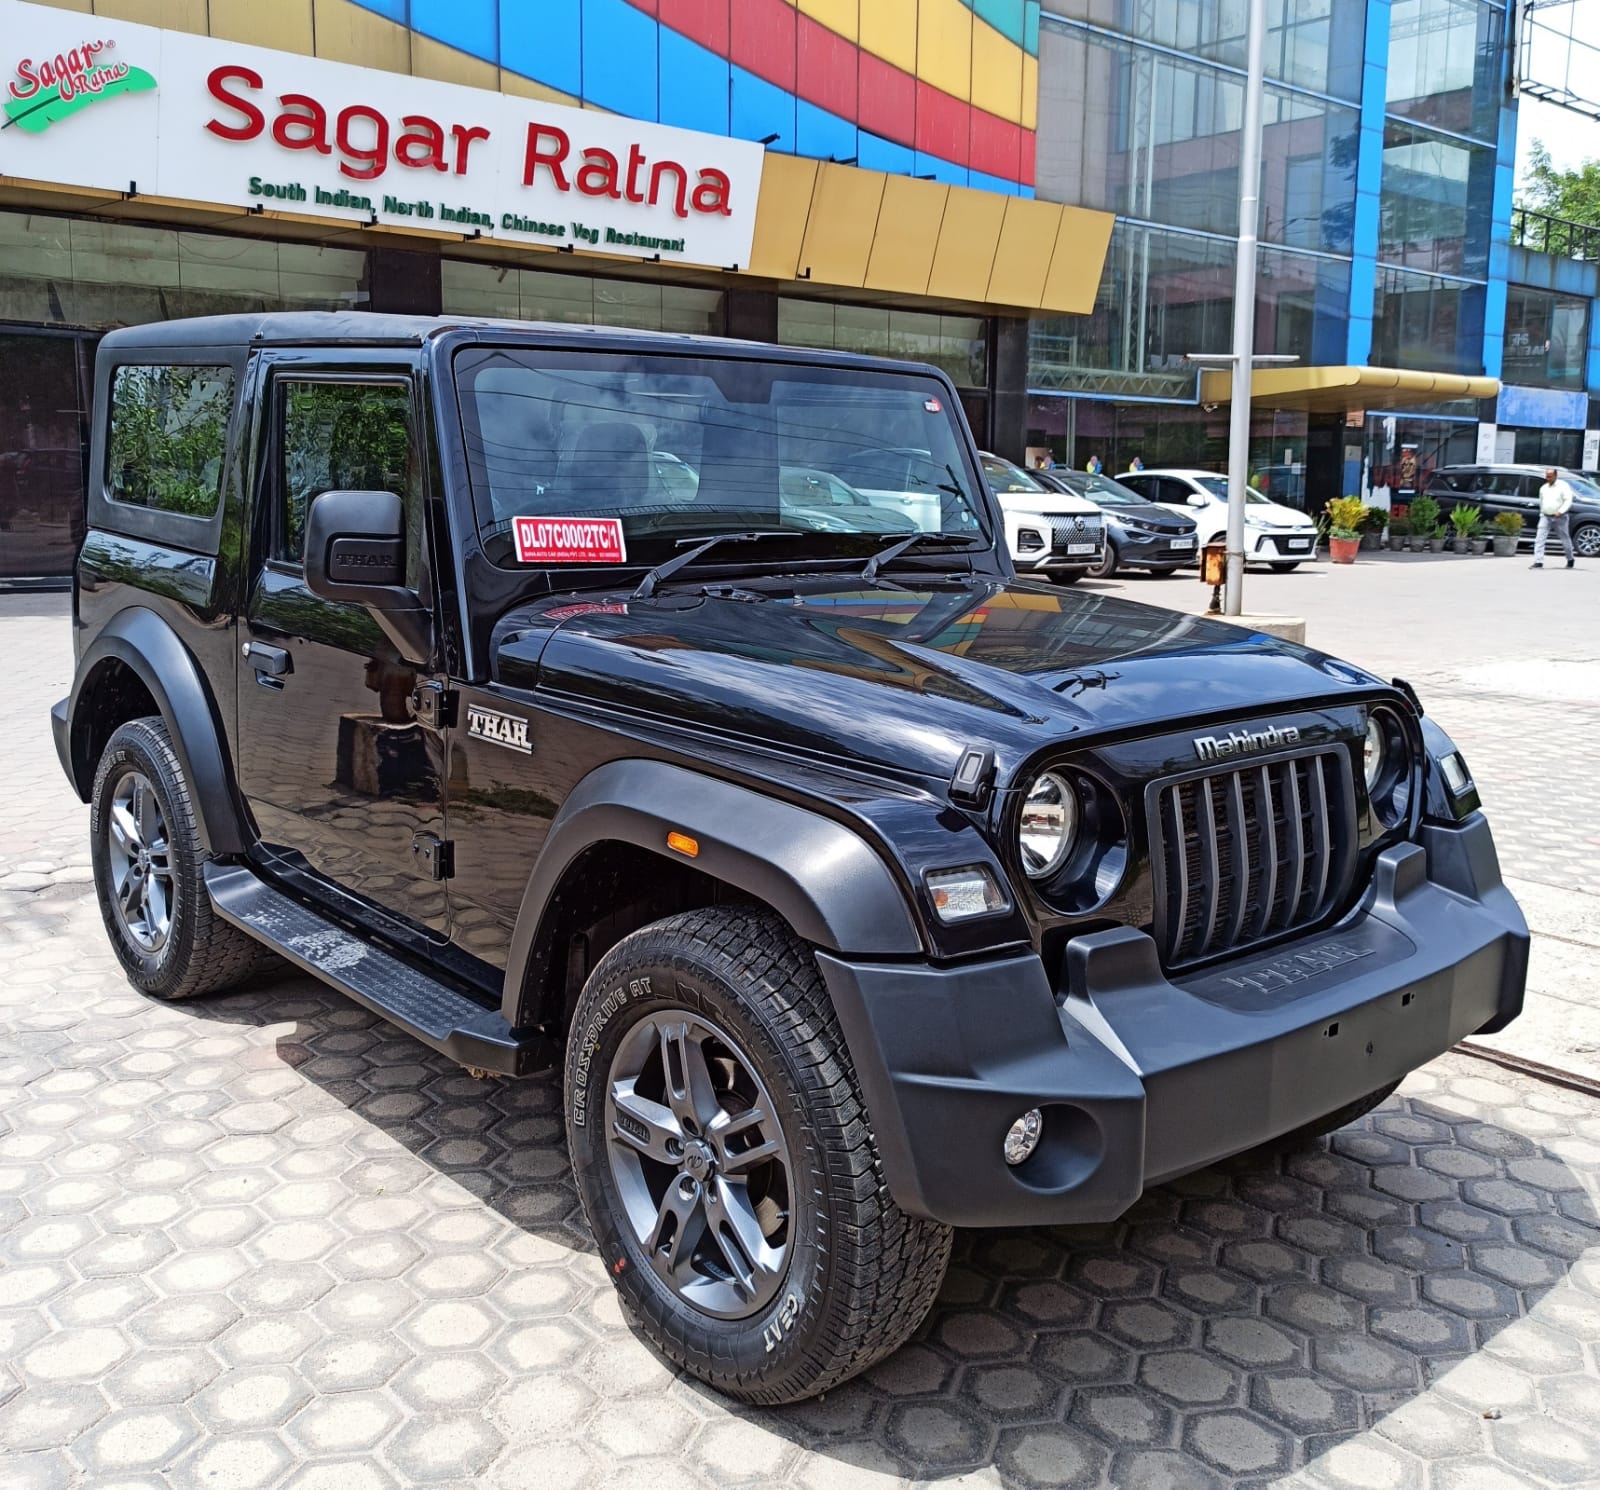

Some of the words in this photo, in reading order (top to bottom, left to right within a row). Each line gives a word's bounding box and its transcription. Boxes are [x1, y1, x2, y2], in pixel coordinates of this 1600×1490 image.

[9, 39, 103, 101] Sagar
[73, 62, 128, 93] Ratna
[204, 65, 491, 181] Sagar
[521, 121, 732, 219] Ratna
[249, 176, 307, 201] South
[315, 185, 376, 215] Indian,
[383, 194, 434, 219] North
[440, 203, 495, 229] Indian,
[502, 213, 566, 237] Chinese
[571, 221, 600, 244] Veg
[605, 227, 685, 252] Restaurant
[520, 523, 619, 549] DL07C0002TC/1
[1193, 725, 1301, 760] Mahindra
[573, 987, 628, 1127] CROSSDRIVE
[629, 977, 652, 997] AT
[763, 1293, 799, 1353] CEAT
